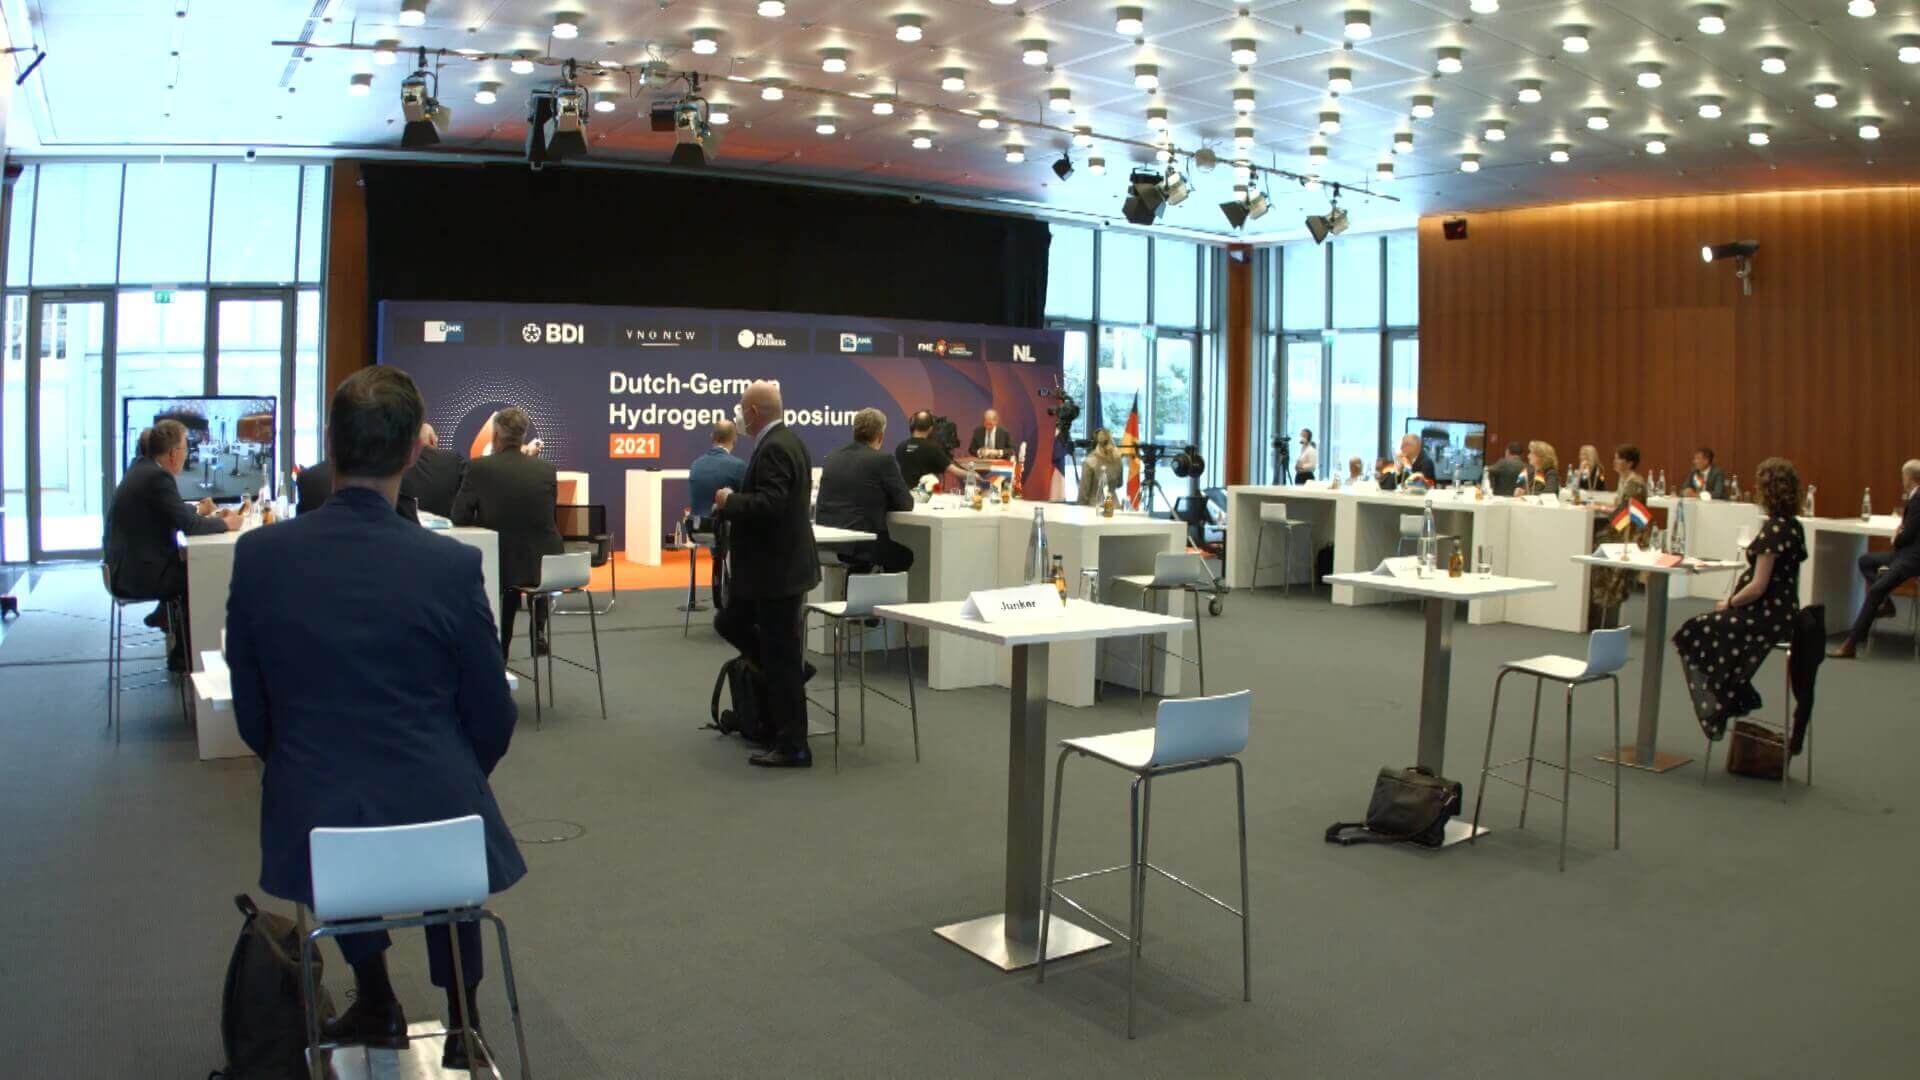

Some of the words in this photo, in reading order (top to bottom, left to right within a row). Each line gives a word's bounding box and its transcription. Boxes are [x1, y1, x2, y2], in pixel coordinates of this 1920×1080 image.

[545, 323, 584, 344] BDI
[625, 329, 657, 340] VNO
[662, 330, 696, 340] NCW
[1013, 344, 1036, 362] NL
[609, 372, 780, 395] Dutch-Germn
[608, 403, 725, 430] Hydrogen
[614, 437, 656, 454] 2021
[1001, 600, 1036, 611] Junker
